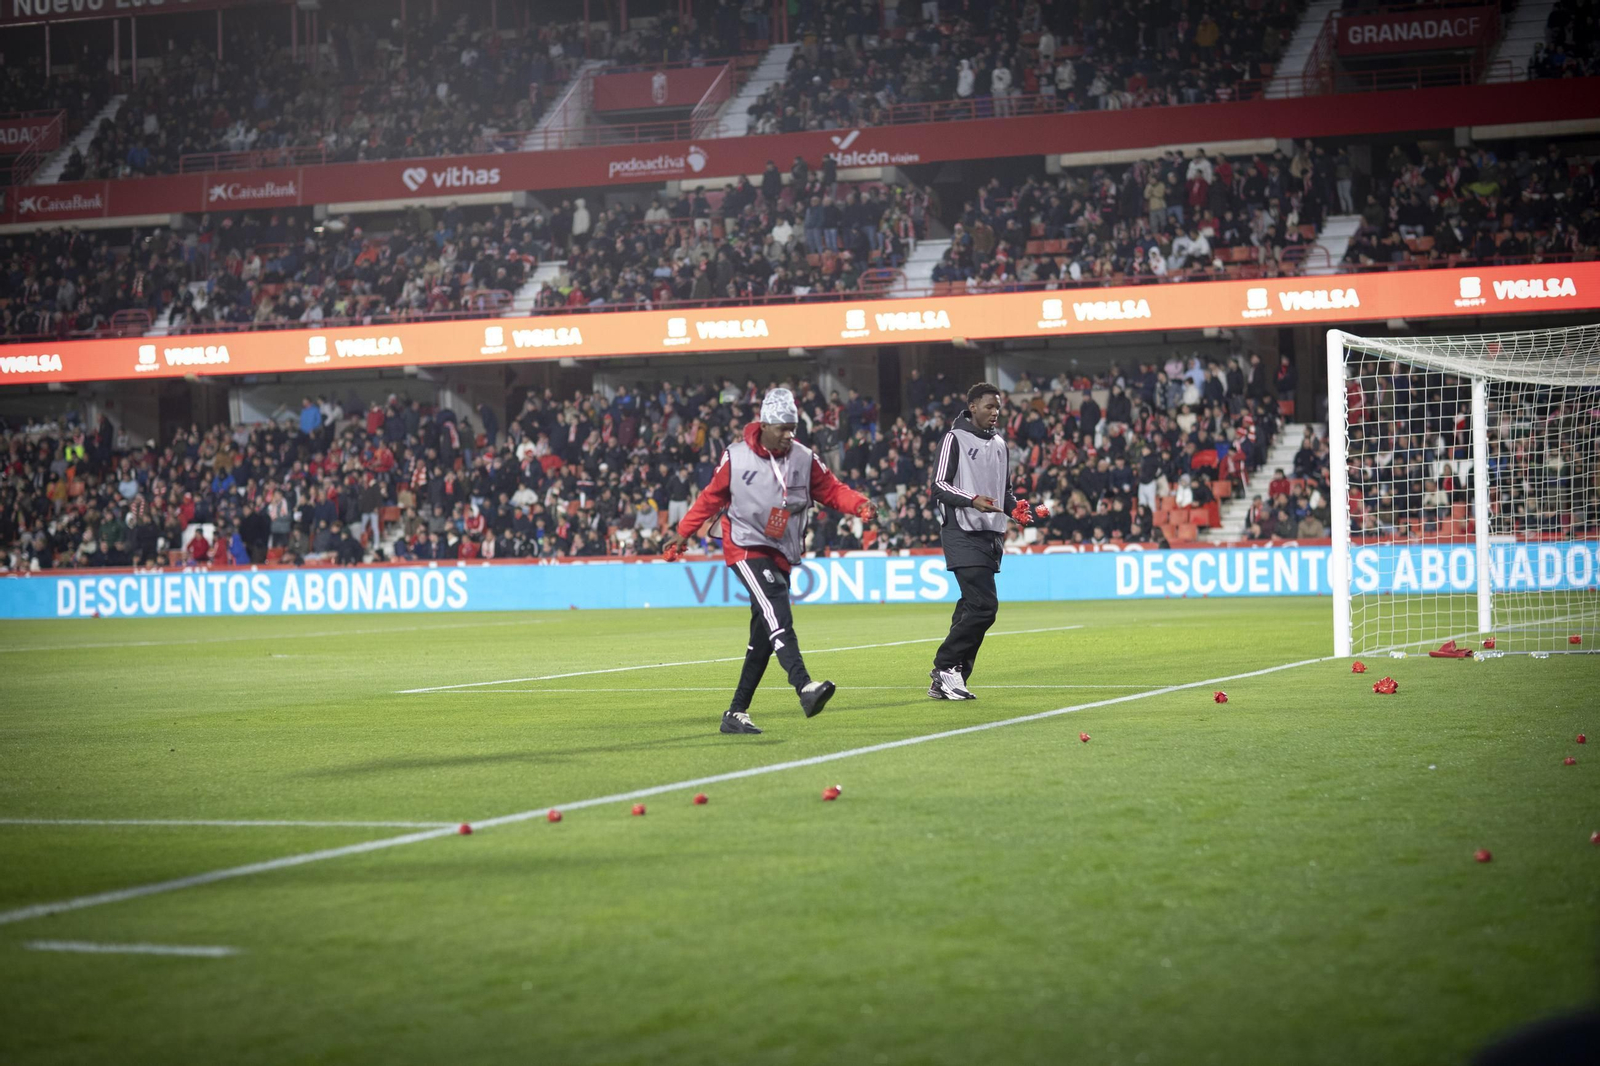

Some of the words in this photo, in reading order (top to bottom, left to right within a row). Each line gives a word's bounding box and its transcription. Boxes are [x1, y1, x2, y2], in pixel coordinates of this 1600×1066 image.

[432, 166, 500, 188] vithas
[608, 155, 685, 179] podoactiva
[227, 180, 297, 200] CaixaBank
[36, 193, 103, 212] CaixaBank
[1492, 277, 1577, 300] VIGILSA
[1073, 299, 1151, 321] VIGILSA
[1278, 288, 1360, 311] VIGILSA
[696, 319, 769, 339] VIGILSA
[875, 310, 951, 331] VIGILSA
[335, 337, 403, 357] VIGILSA
[512, 327, 583, 347] VIGILSA
[164, 346, 230, 366] VIGILSA
[1392, 544, 1600, 590] ABONADO
[57, 573, 271, 617] DESCUENTOS
[281, 569, 468, 612] ABONADOS
